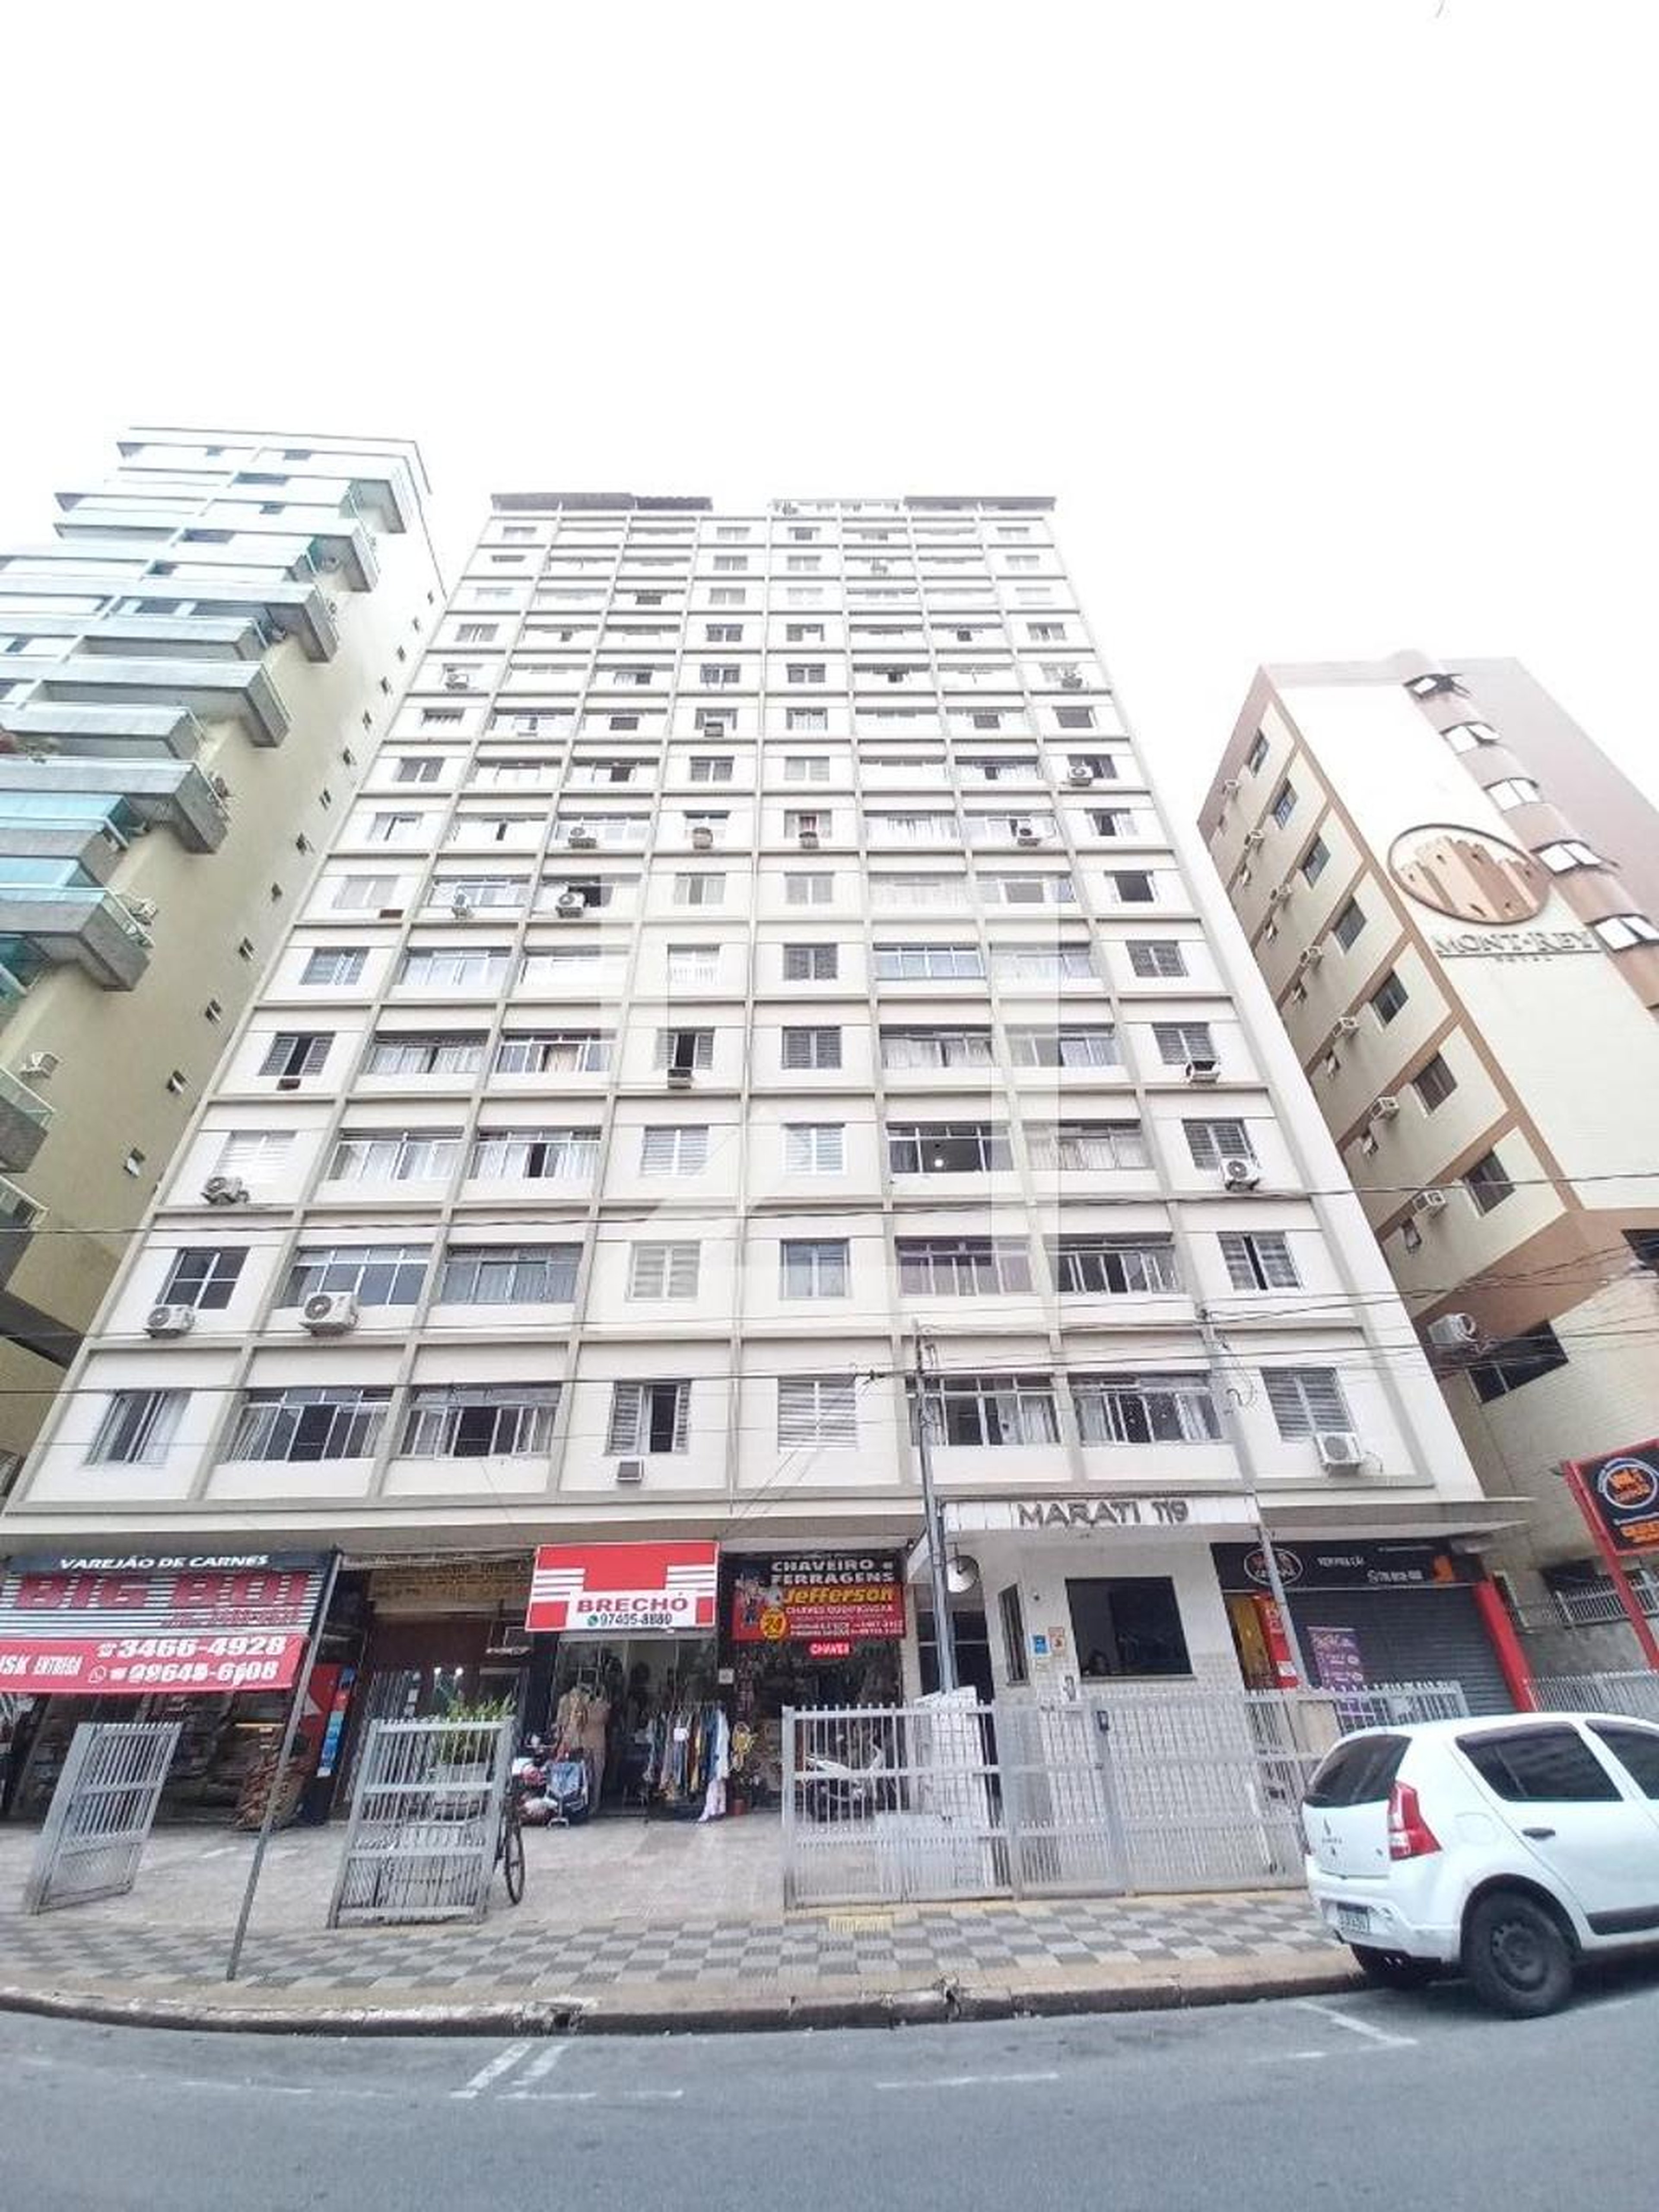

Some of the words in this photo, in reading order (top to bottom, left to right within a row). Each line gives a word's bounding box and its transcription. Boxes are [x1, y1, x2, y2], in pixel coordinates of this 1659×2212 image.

[1018, 1501, 1141, 1526] MARATI
[1152, 1500, 1188, 1524] 119
[60, 1555, 154, 1569] VAREJÃO
[157, 1556, 186, 1568] DE
[189, 1555, 269, 1567] CARNES
[771, 1559, 874, 1572] CHAVEIRO
[771, 1572, 895, 1584] FERRAGENS
[16, 1574, 149, 1608] BIG
[784, 1588, 894, 1604] Jefferson
[577, 1592, 688, 1613] BRECHÓ
